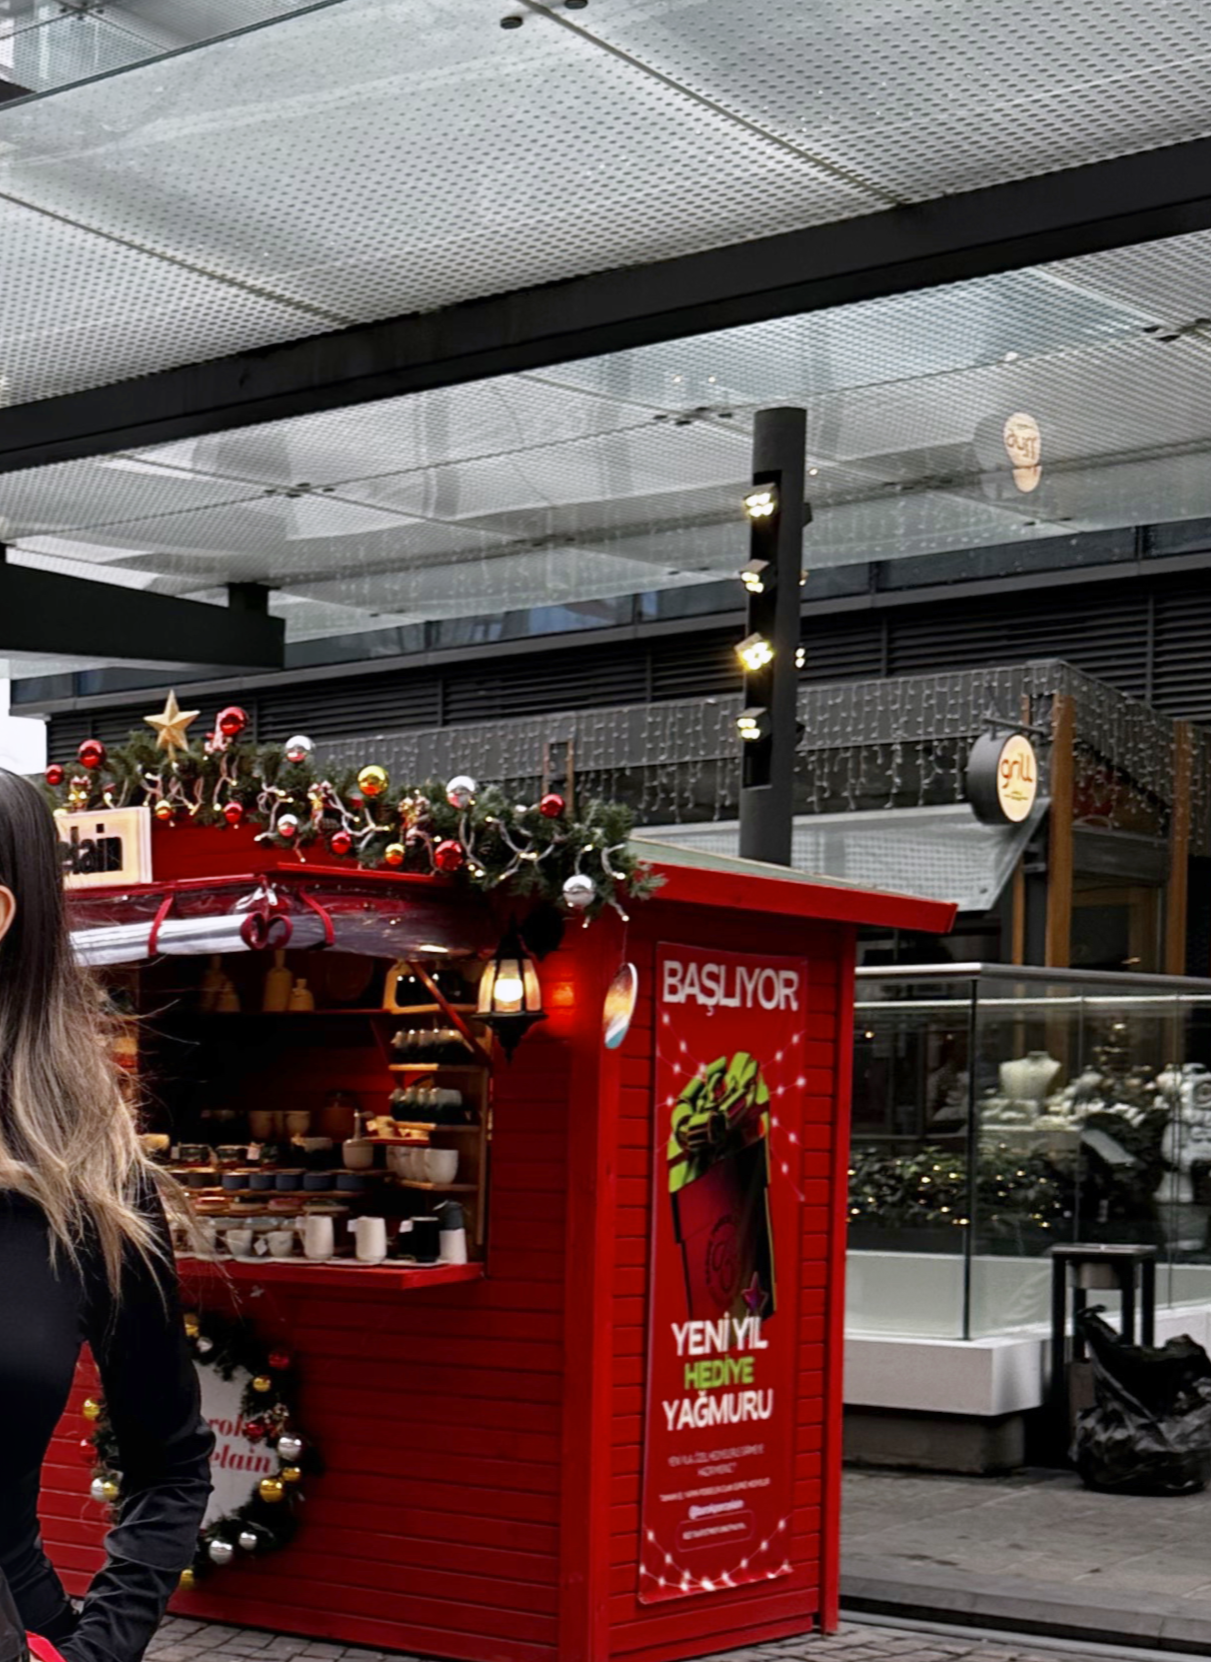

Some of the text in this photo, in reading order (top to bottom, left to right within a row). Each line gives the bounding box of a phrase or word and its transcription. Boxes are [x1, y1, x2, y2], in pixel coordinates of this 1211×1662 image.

[663, 960, 799, 1016] BAŞLIYOR
[671, 1311, 769, 1356] YENİ YIL
[684, 1354, 755, 1390] HEDİYE
[662, 1388, 773, 1431] YAĞMURU
